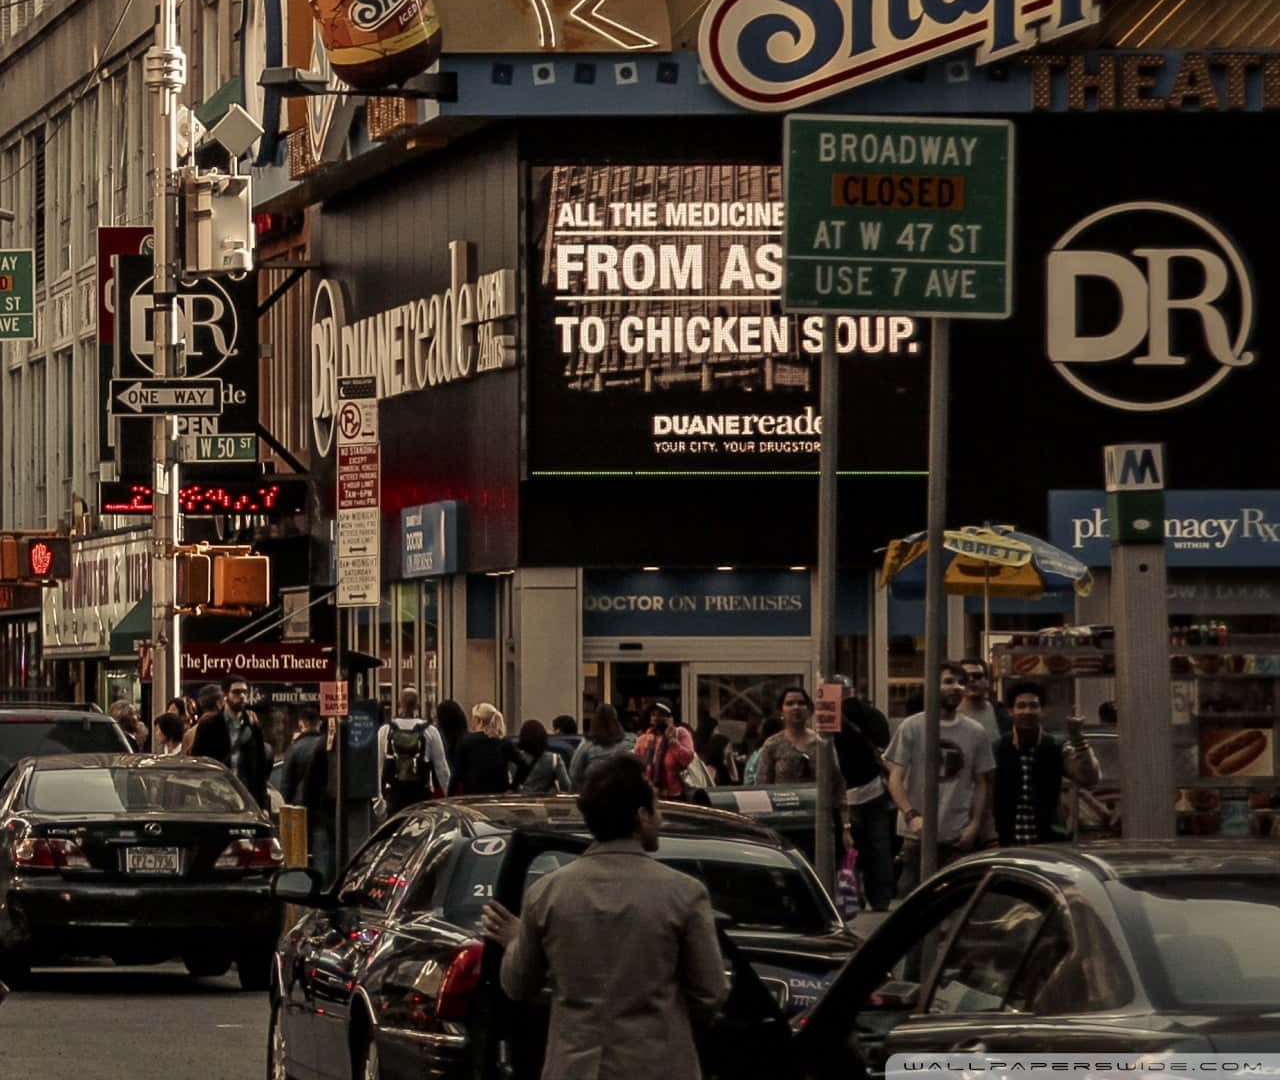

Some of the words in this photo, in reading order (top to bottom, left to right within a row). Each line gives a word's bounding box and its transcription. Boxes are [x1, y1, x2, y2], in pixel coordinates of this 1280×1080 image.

[1028, 52, 1280, 114] THEAT
[818, 132, 979, 167] BROADWAY
[841, 176, 957, 209] CLOSED
[558, 202, 604, 228] ALL
[608, 201, 658, 227] THE
[665, 201, 784, 227] MEDICINE
[813, 224, 847, 252] AT
[859, 223, 883, 252] W
[896, 222, 936, 254] 47
[947, 224, 983, 255] ST
[555, 243, 711, 293] FROM
[720, 244, 783, 290] AS
[815, 266, 873, 297] USE
[890, 267, 907, 298] 7
[924, 268, 978, 300] AVE
[5, 296, 21, 312] ST
[405, 239, 474, 392] reade
[1047, 247, 1255, 367] DR
[555, 316, 606, 354] TO
[619, 316, 787, 354] CHICKEN
[801, 315, 919, 354] SOUP.
[128, 390, 159, 404] ONE
[174, 390, 208, 404] WAY
[653, 414, 740, 436] DUANE
[200, 438, 213, 458] W
[217, 438, 235, 458] 50
[240, 438, 253, 449] ST
[654, 441, 686, 454] YOUR
[689, 441, 718, 454] CITY.
[723, 441, 756, 454] YOUR
[1071, 507, 1239, 549] phmacy
[1173, 540, 1211, 550] WITHIN
[584, 594, 665, 613] DOCTOR
[668, 594, 699, 612] ON
[703, 593, 803, 612] PREMISES
[180, 654, 201, 670] The
[201, 654, 233, 674] Jerry
[234, 653, 278, 670] Orbach
[280, 654, 329, 670] Theater
